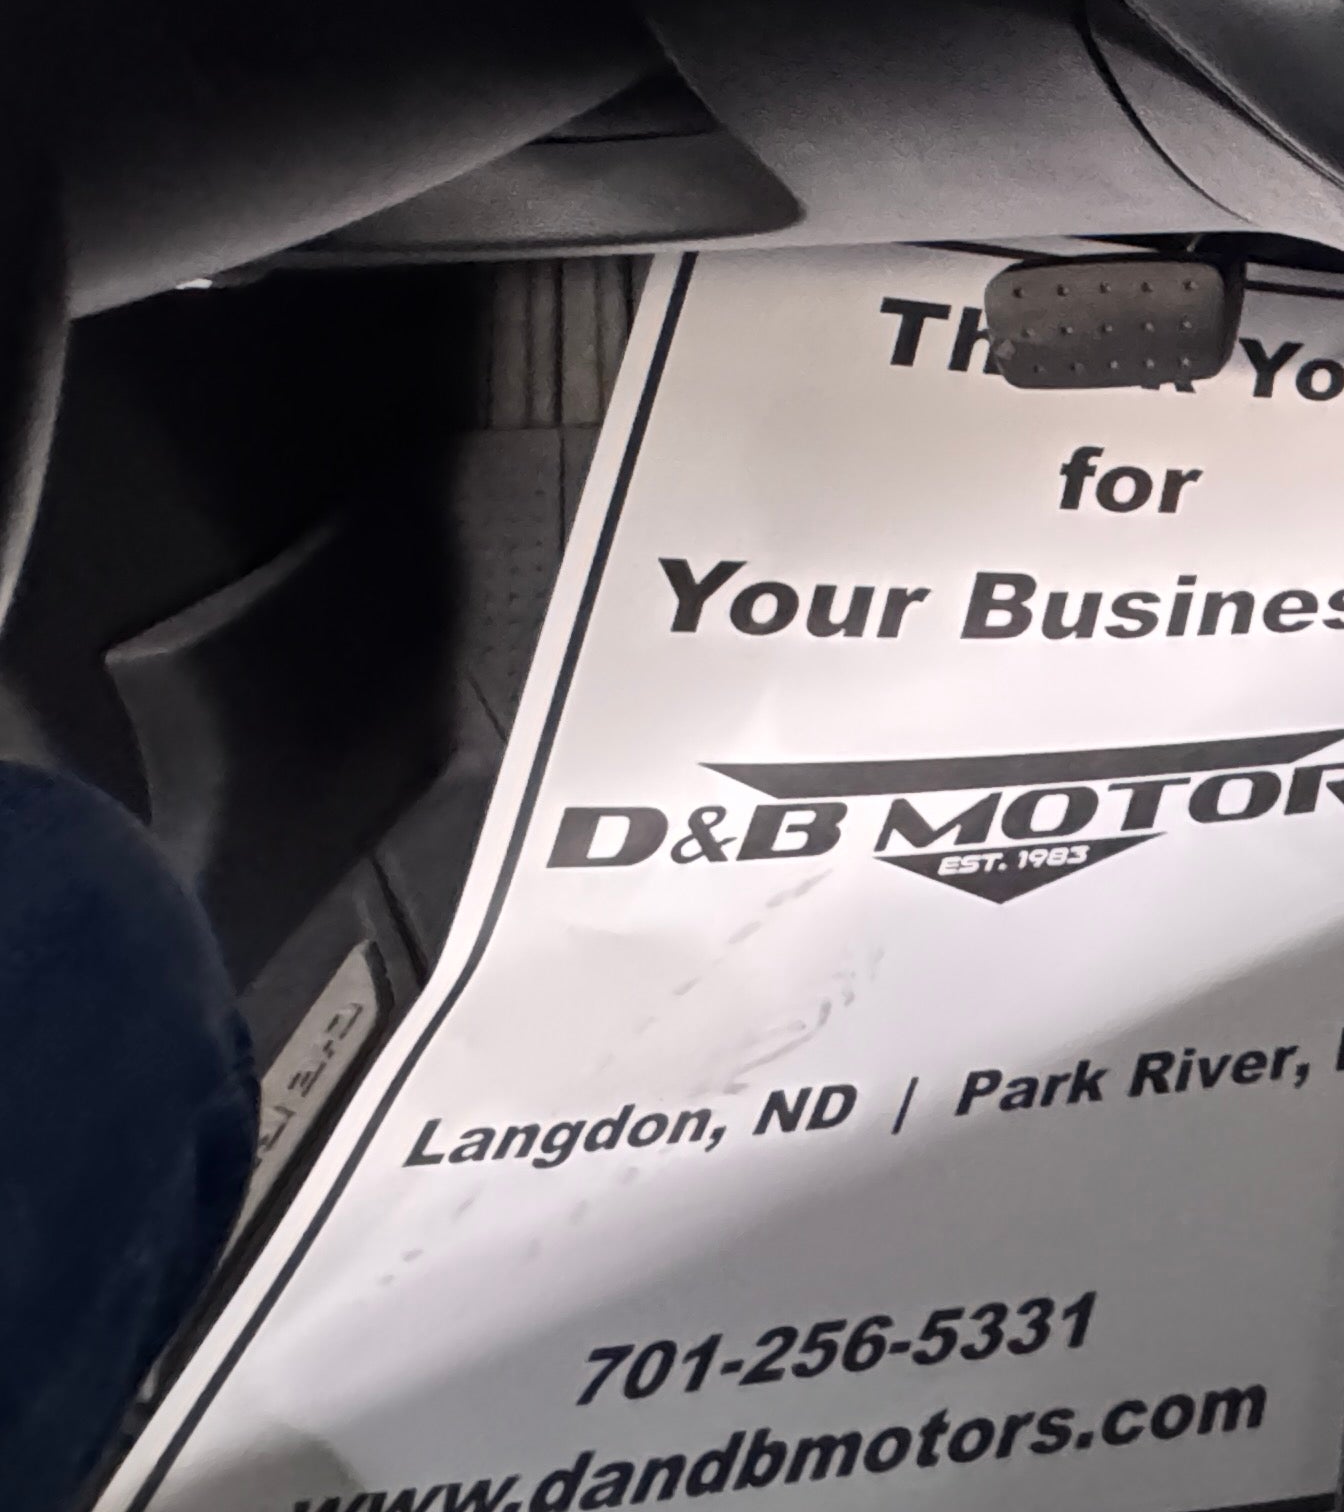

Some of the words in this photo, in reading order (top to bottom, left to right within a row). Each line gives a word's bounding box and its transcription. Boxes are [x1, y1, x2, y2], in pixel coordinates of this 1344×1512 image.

[1059, 445, 1203, 514] for
[657, 557, 931, 638] Your
[546, 799, 848, 869] D&B
[936, 852, 1009, 876] EST.
[1016, 843, 1091, 871] 1983
[402, 1102, 728, 1170] Langdon,
[752, 1084, 858, 1136] ND
[954, 1058, 1106, 1118] Park
[1127, 1045, 1310, 1098] River,
[575, 1290, 1099, 1406] 701-256-5331
